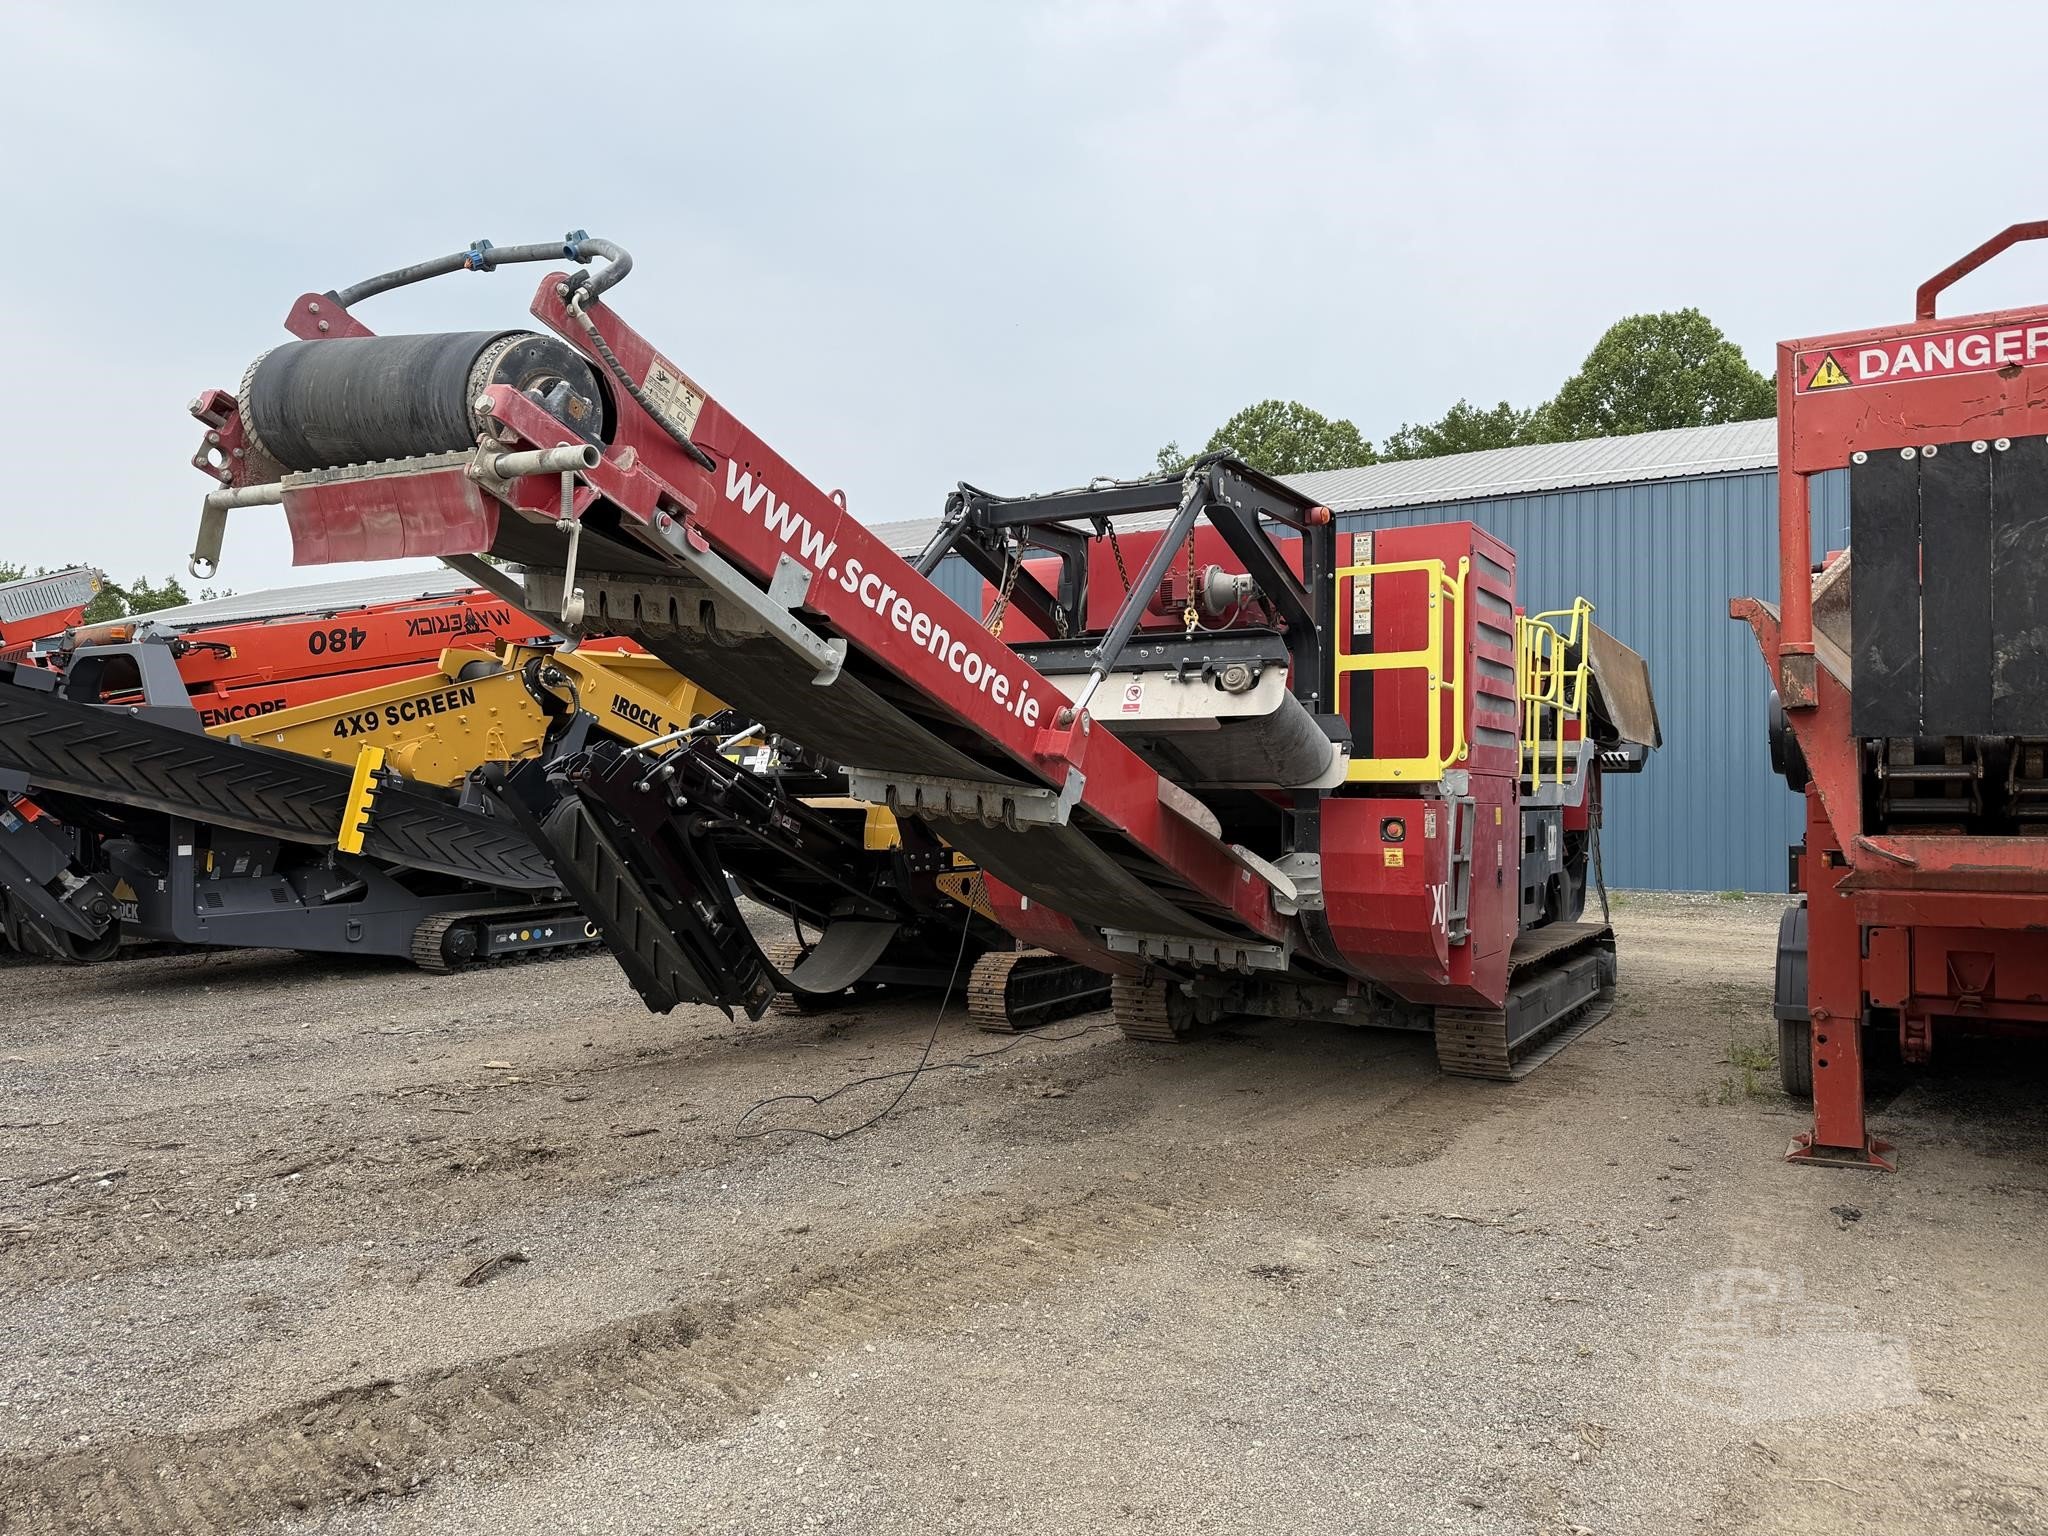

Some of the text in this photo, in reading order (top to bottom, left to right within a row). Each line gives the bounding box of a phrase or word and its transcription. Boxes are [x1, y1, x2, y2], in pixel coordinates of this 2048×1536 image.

[1859, 326, 2048, 380] DANGER
[725, 458, 1040, 728] www.screencore.ie
[308, 626, 367, 655] 480
[333, 686, 477, 739] 4X9 SCREEN
[610, 693, 662, 733] IROCK
[1431, 883, 1446, 934] XJ
